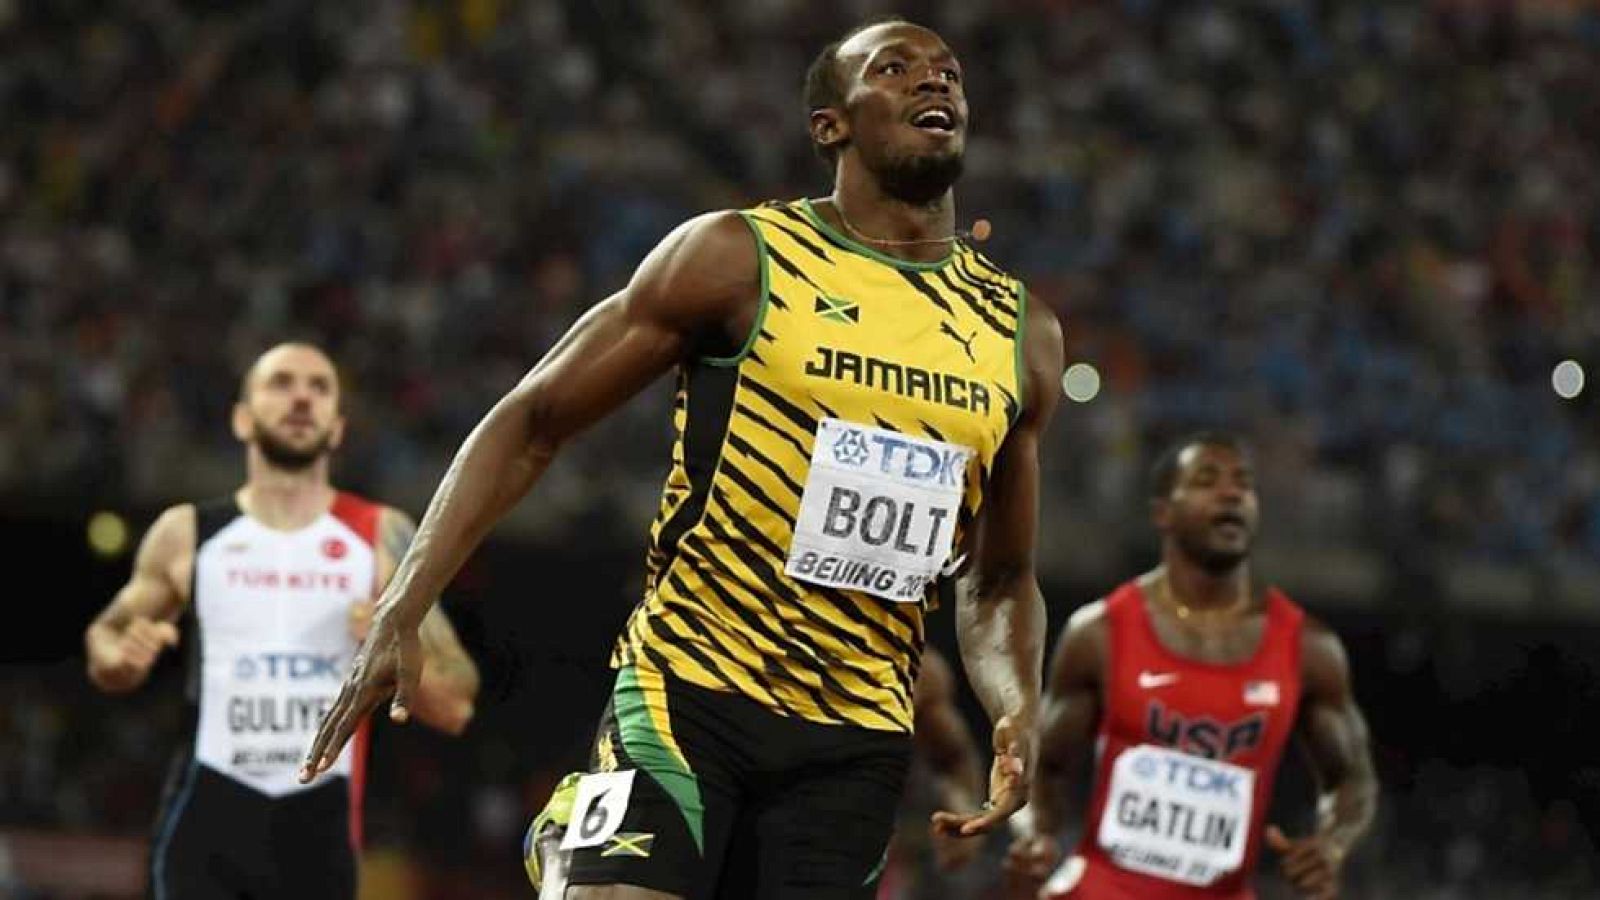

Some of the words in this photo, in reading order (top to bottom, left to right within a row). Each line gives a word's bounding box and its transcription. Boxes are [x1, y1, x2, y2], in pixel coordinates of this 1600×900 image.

[805, 347, 990, 414] JAMAICA
[872, 435, 964, 486] TDK
[822, 486, 948, 557] BOLT
[795, 552, 897, 591] BEIJING
[264, 654, 341, 678] TDK
[1147, 699, 1267, 758] USA
[1164, 757, 1240, 797] TDK
[580, 787, 612, 839] 6
[1117, 792, 1237, 849] GATLIN
